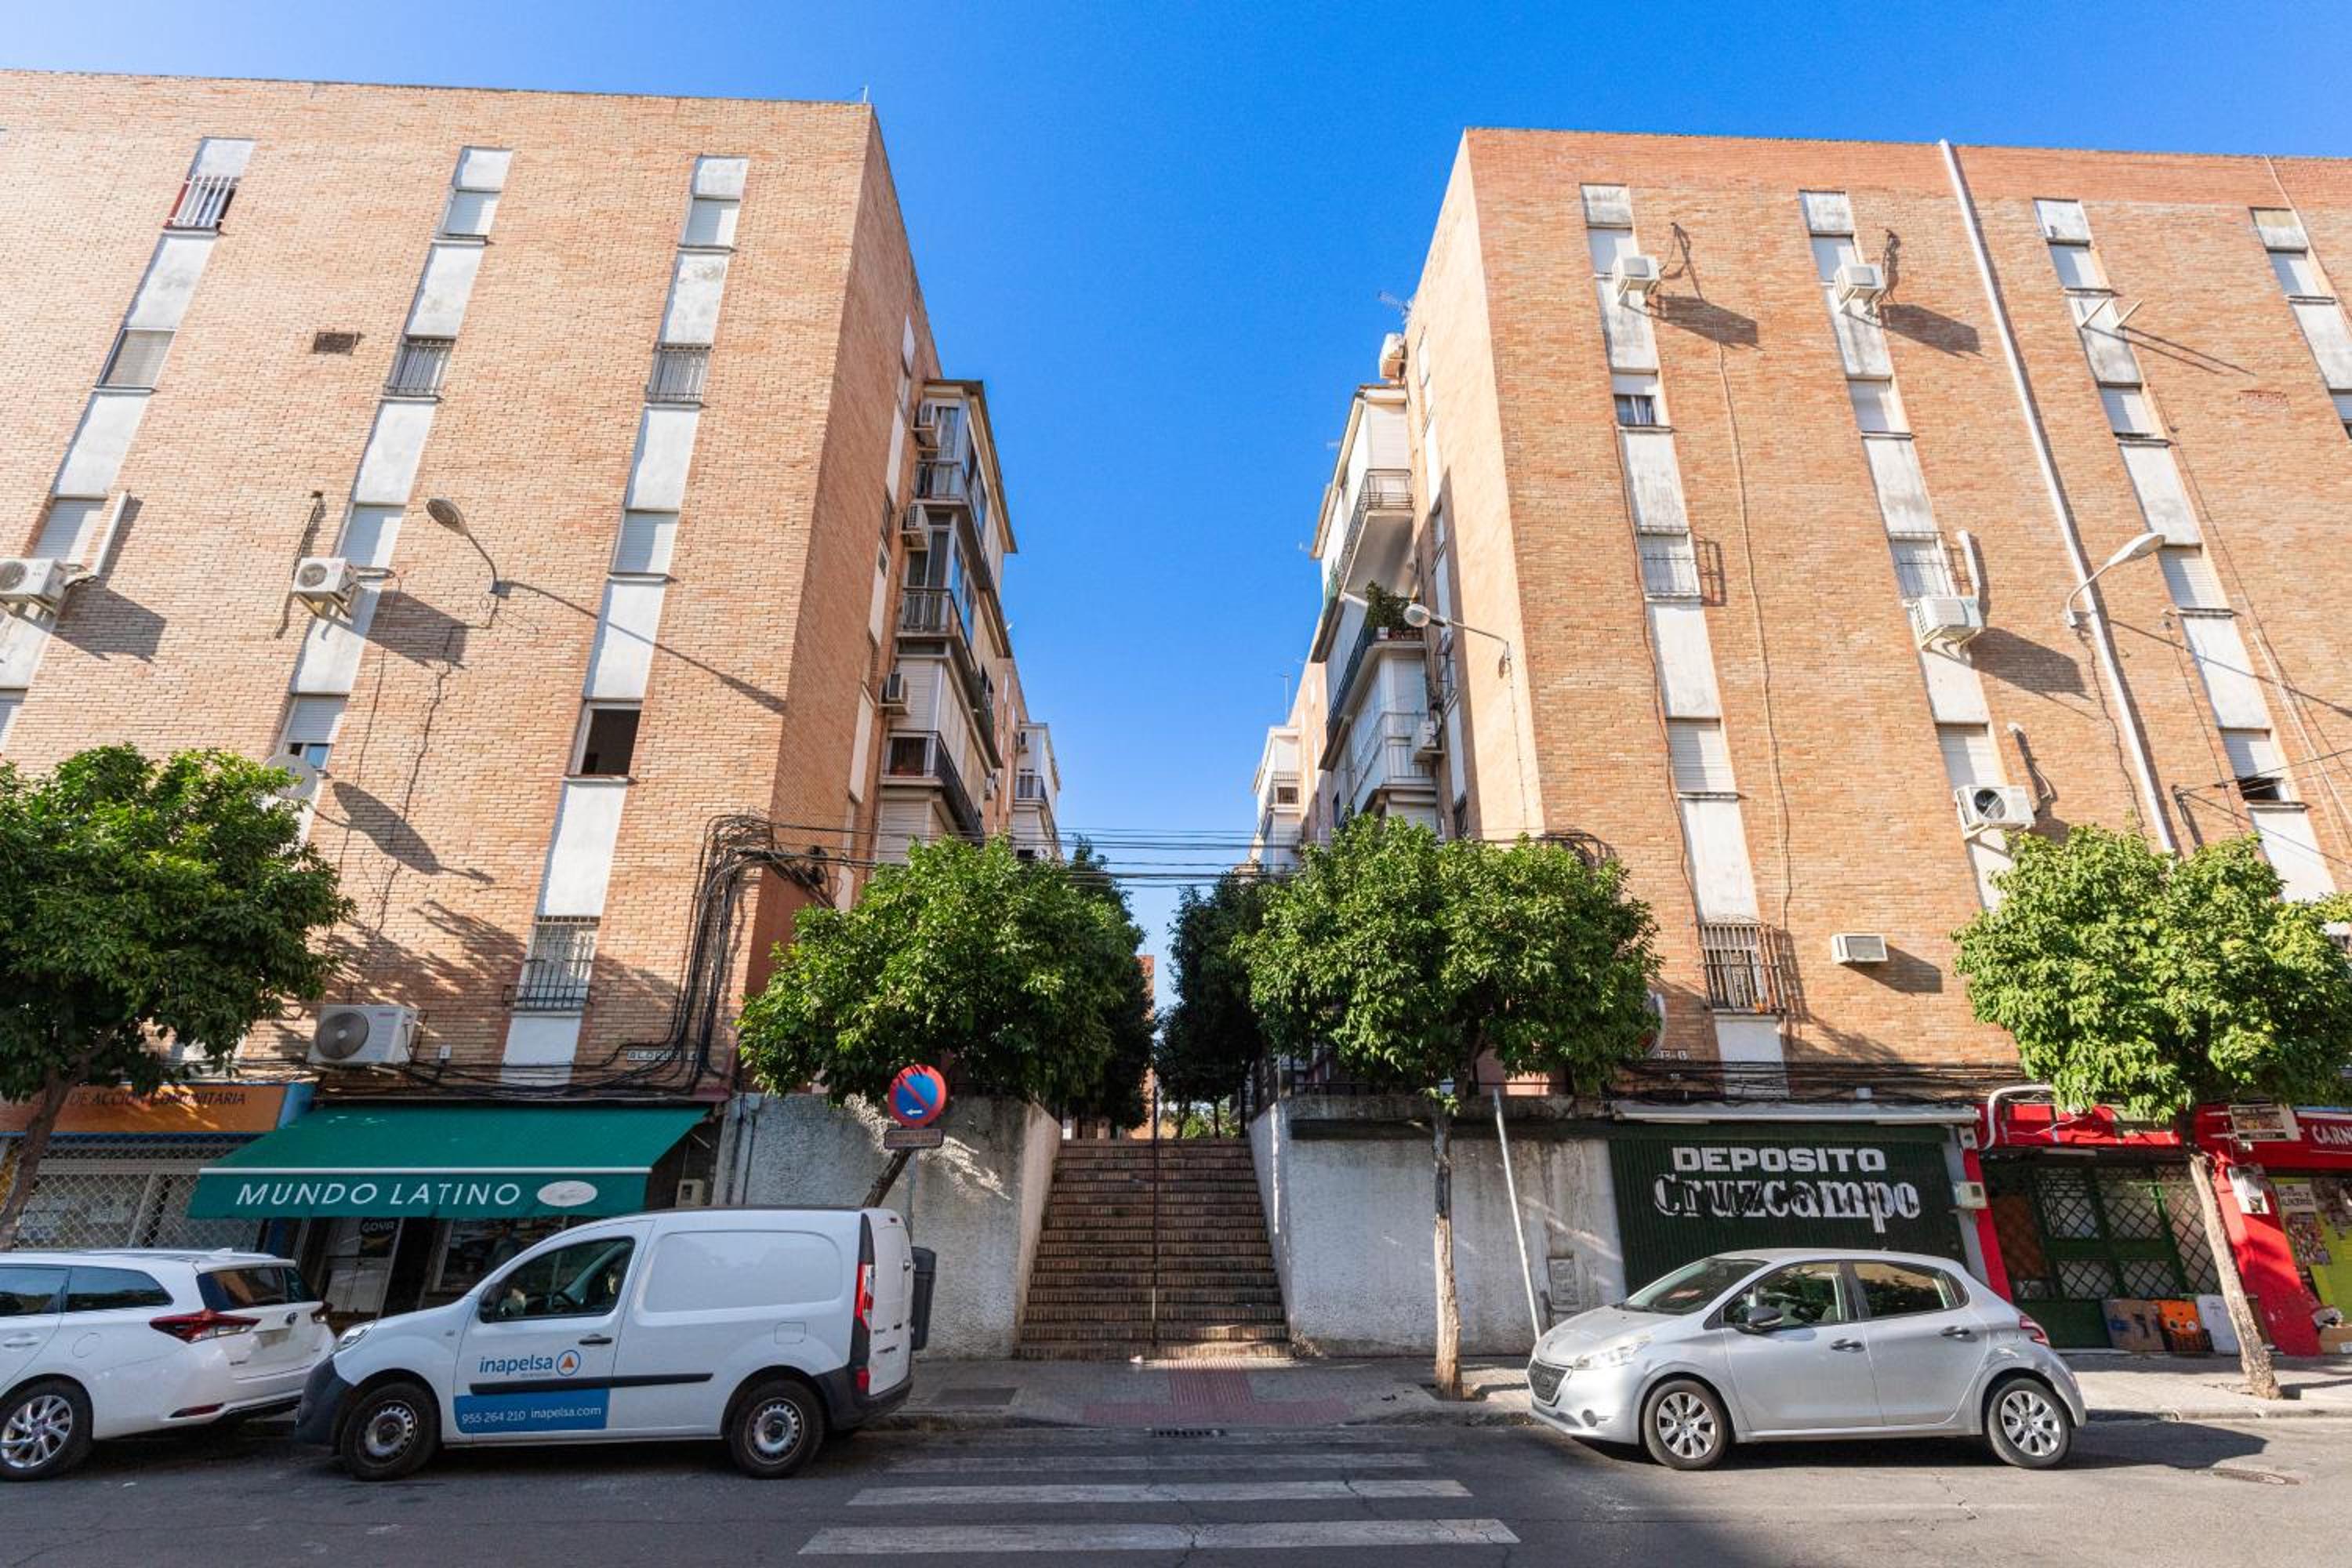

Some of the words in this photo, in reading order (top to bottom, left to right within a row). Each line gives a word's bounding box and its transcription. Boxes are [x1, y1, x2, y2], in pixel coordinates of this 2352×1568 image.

[1672, 1147, 1886, 1172] DEPOSITO
[236, 1183, 378, 1205] MUNDO
[390, 1183, 521, 1205] LATINO
[1653, 1174, 1921, 1233] Cruzcampo
[479, 1355, 553, 1375] inapelsa
[462, 1413, 481, 1424] 955
[484, 1411, 504, 1423] 264
[506, 1410, 526, 1421] 210
[531, 1406, 601, 1418] inapelsa.com
